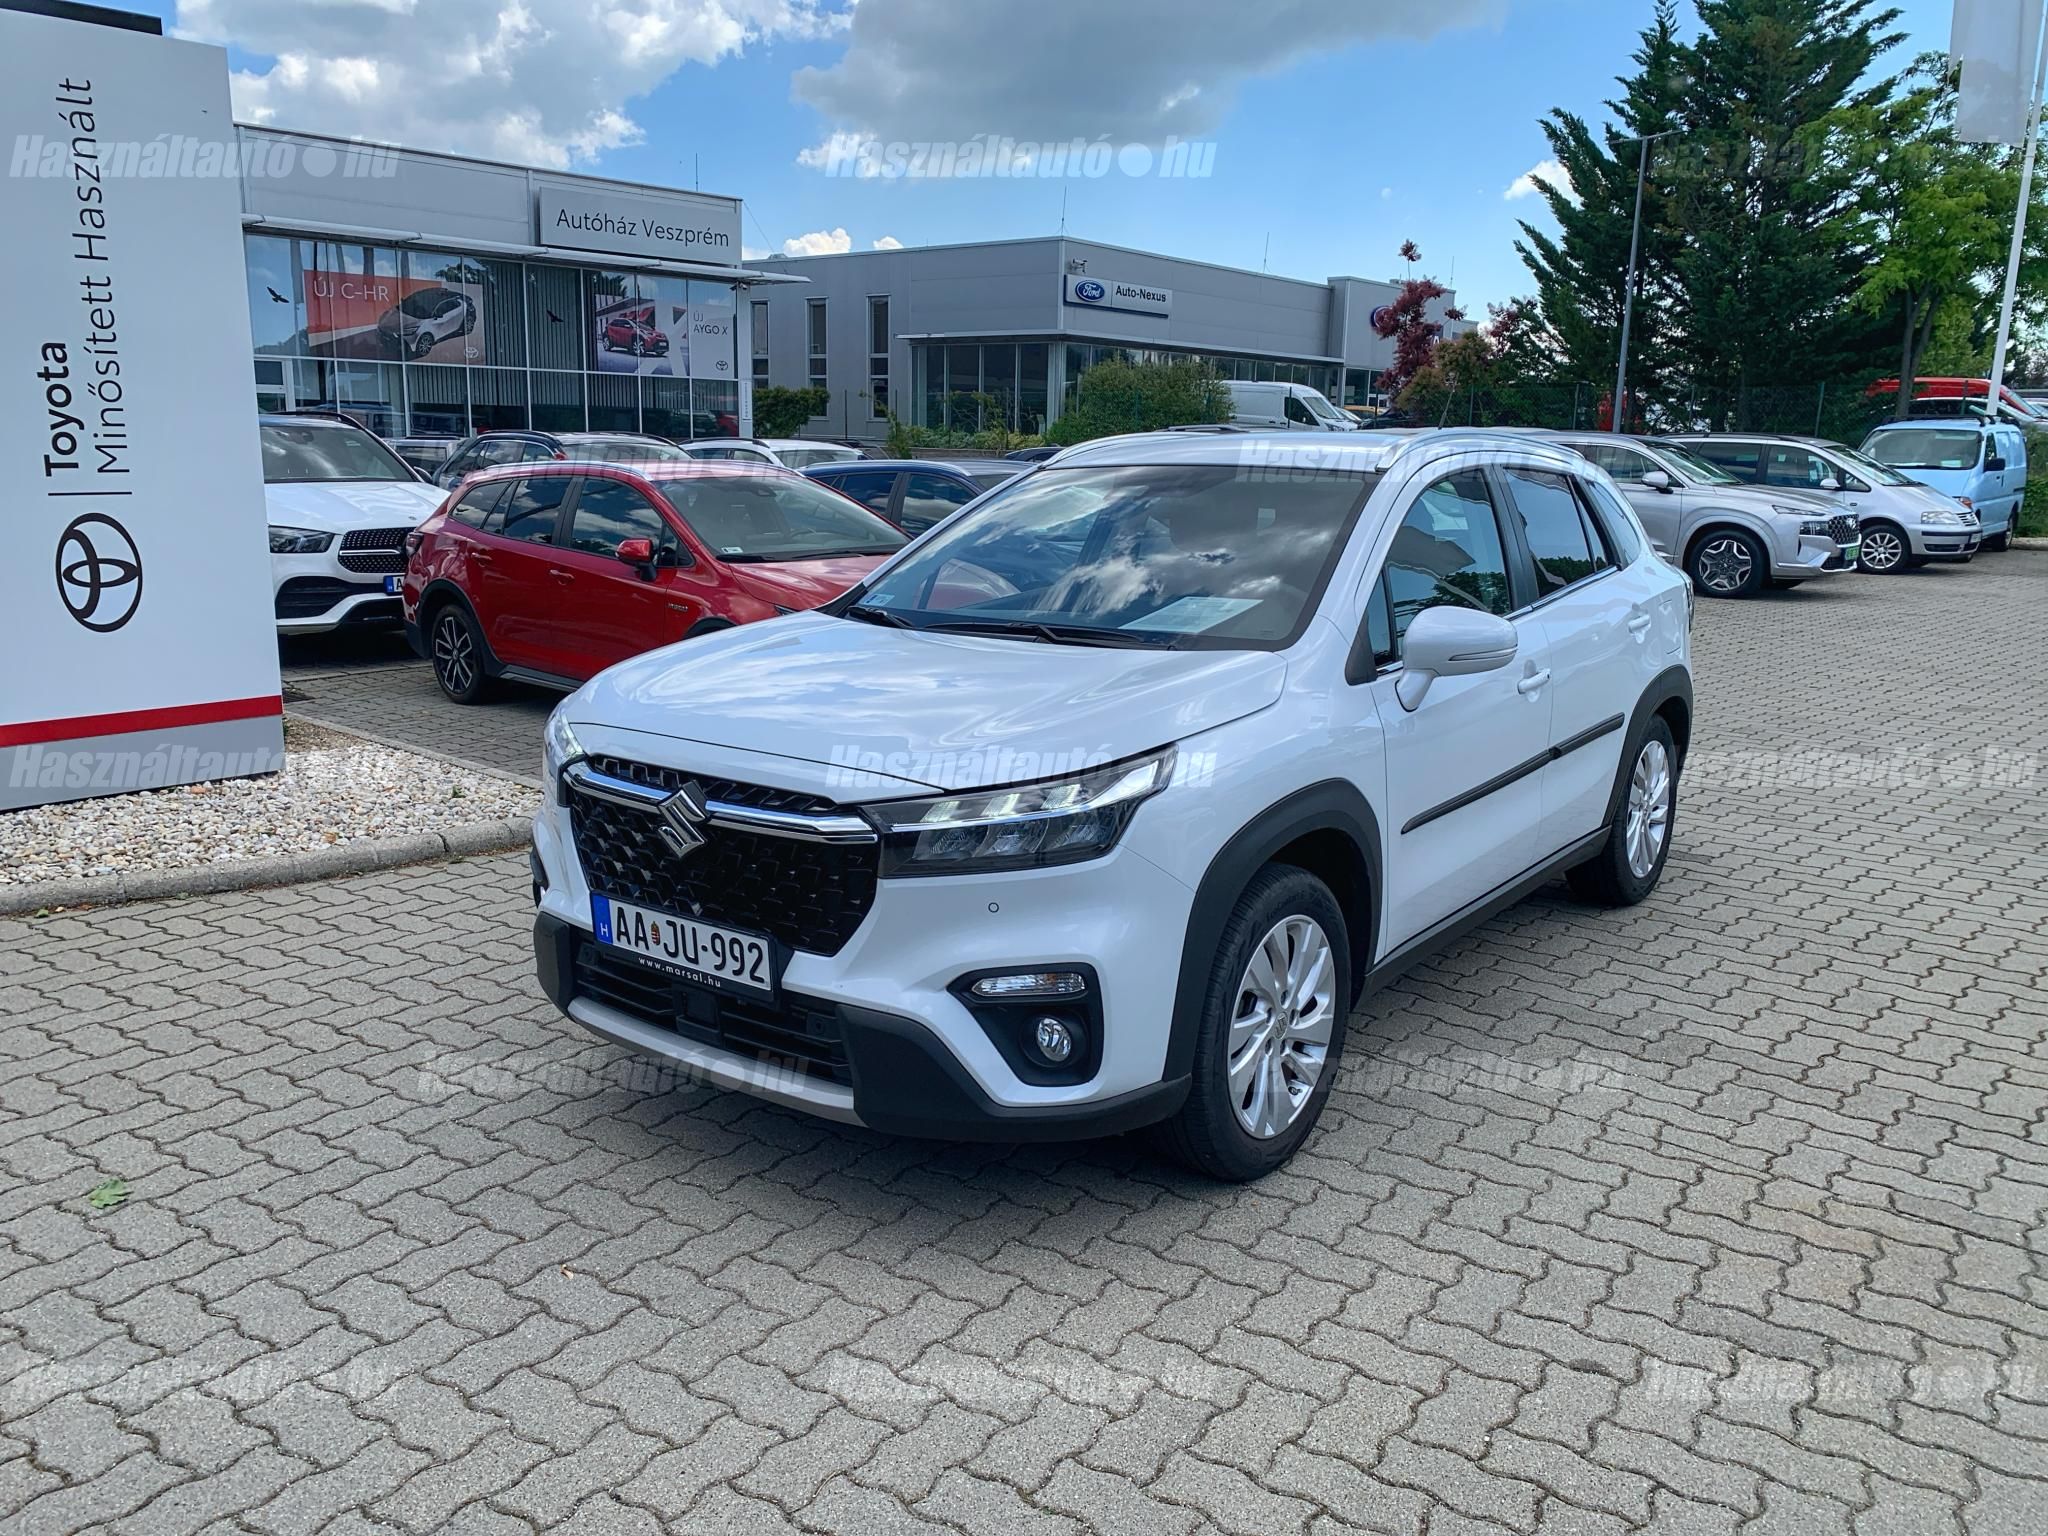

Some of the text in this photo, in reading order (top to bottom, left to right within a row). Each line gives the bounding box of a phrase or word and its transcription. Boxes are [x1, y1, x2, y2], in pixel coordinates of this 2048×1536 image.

[556, 208, 730, 247] Autóház Veszprém
[56, 77, 130, 473] Minősített Használt
[313, 276, 390, 302] ÚJ C-HR
[1082, 283, 1101, 298] Ford
[1115, 285, 1167, 303] Auto-Nexus
[693, 323, 729, 336] AYGO X
[37, 342, 85, 477] Toyota
[599, 922, 609, 938] H
[638, 956, 722, 988] www.marsal.hu
